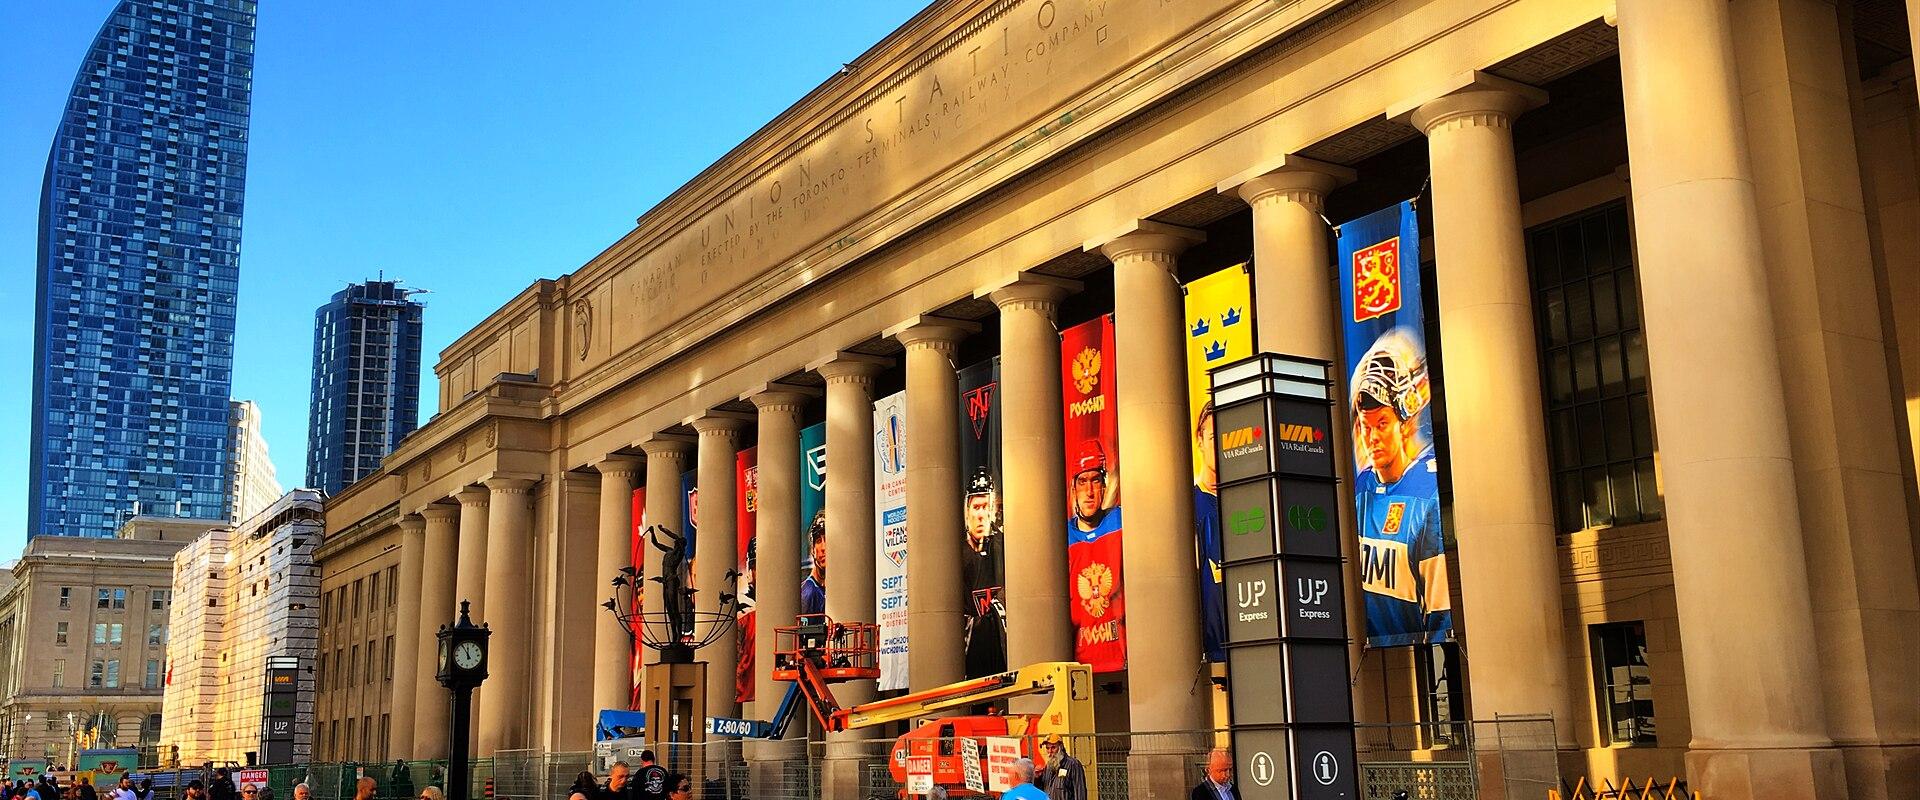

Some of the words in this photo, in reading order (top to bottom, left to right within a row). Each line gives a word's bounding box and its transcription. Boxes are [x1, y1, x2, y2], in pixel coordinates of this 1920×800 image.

[701, 158, 811, 248] UNION
[864, 0, 1060, 144] STATIO
[749, 220, 761, 237] BY
[766, 206, 783, 225] THE
[793, 167, 846, 209] TORONTO
[856, 113, 931, 169] TERMINALS
[942, 62, 1009, 116] RAILWAY
[1025, 1, 1107, 63] COMPANY
[1222, 427, 1253, 450] VIA
[1280, 423, 1313, 443] VIA
[1223, 450, 1236, 459] VIA
[1235, 446, 1245, 456] Rail
[1244, 443, 1263, 455] Canada
[1281, 442, 1293, 451] VIA
[1293, 443, 1304, 451] Rail
[1304, 445, 1324, 454] Canada
[893, 526, 905, 538] FAN
[881, 575, 903, 590] SEPT
[1238, 579, 1266, 608] UP
[1298, 577, 1328, 605] UP
[881, 595, 903, 610] SEPT
[1239, 611, 1268, 623] Express
[1299, 608, 1330, 620] Express
[274, 721, 288, 731] UP
[717, 720, 751, 735] Z-80/60
[908, 759, 931, 773] DANGER
[241, 771, 267, 780] DANGER
